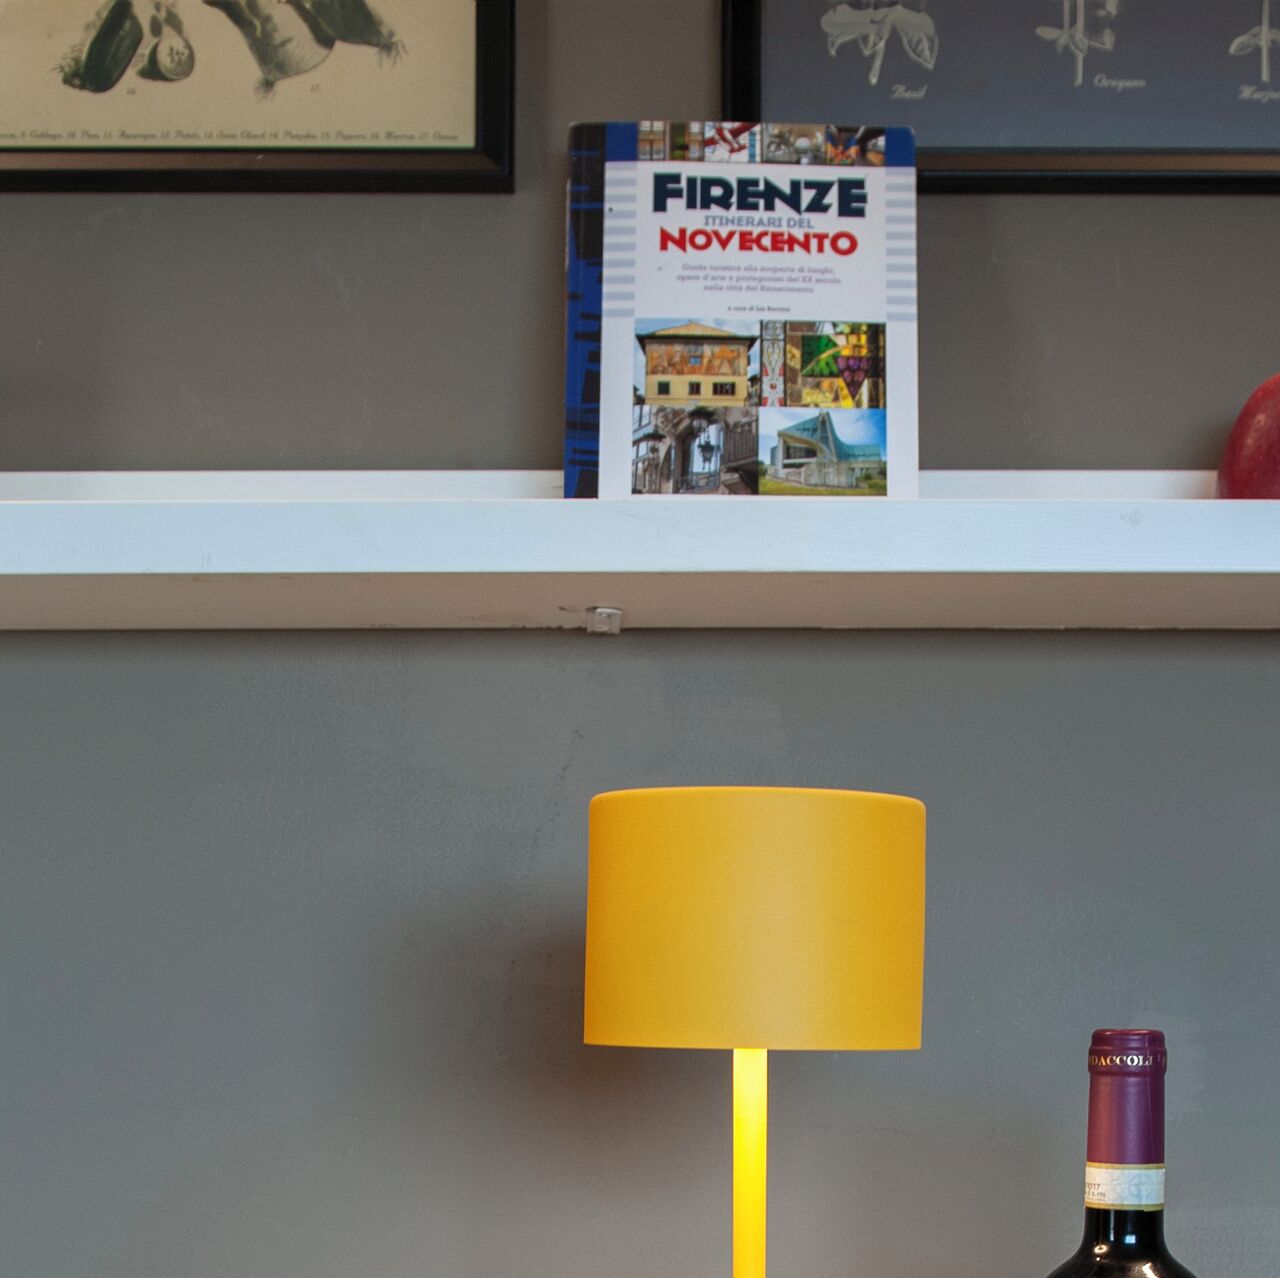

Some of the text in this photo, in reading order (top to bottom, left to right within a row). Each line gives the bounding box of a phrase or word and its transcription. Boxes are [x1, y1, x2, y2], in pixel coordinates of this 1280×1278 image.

[891, 84, 928, 99] Basil
[652, 172, 868, 218] FIRENZE
[703, 215, 814, 229] ITINERARI DEL
[659, 226, 859, 256] NOVECENTO
[681, 262, 707, 272] Guida
[1089, 1055, 1153, 1066] DACCOLI
